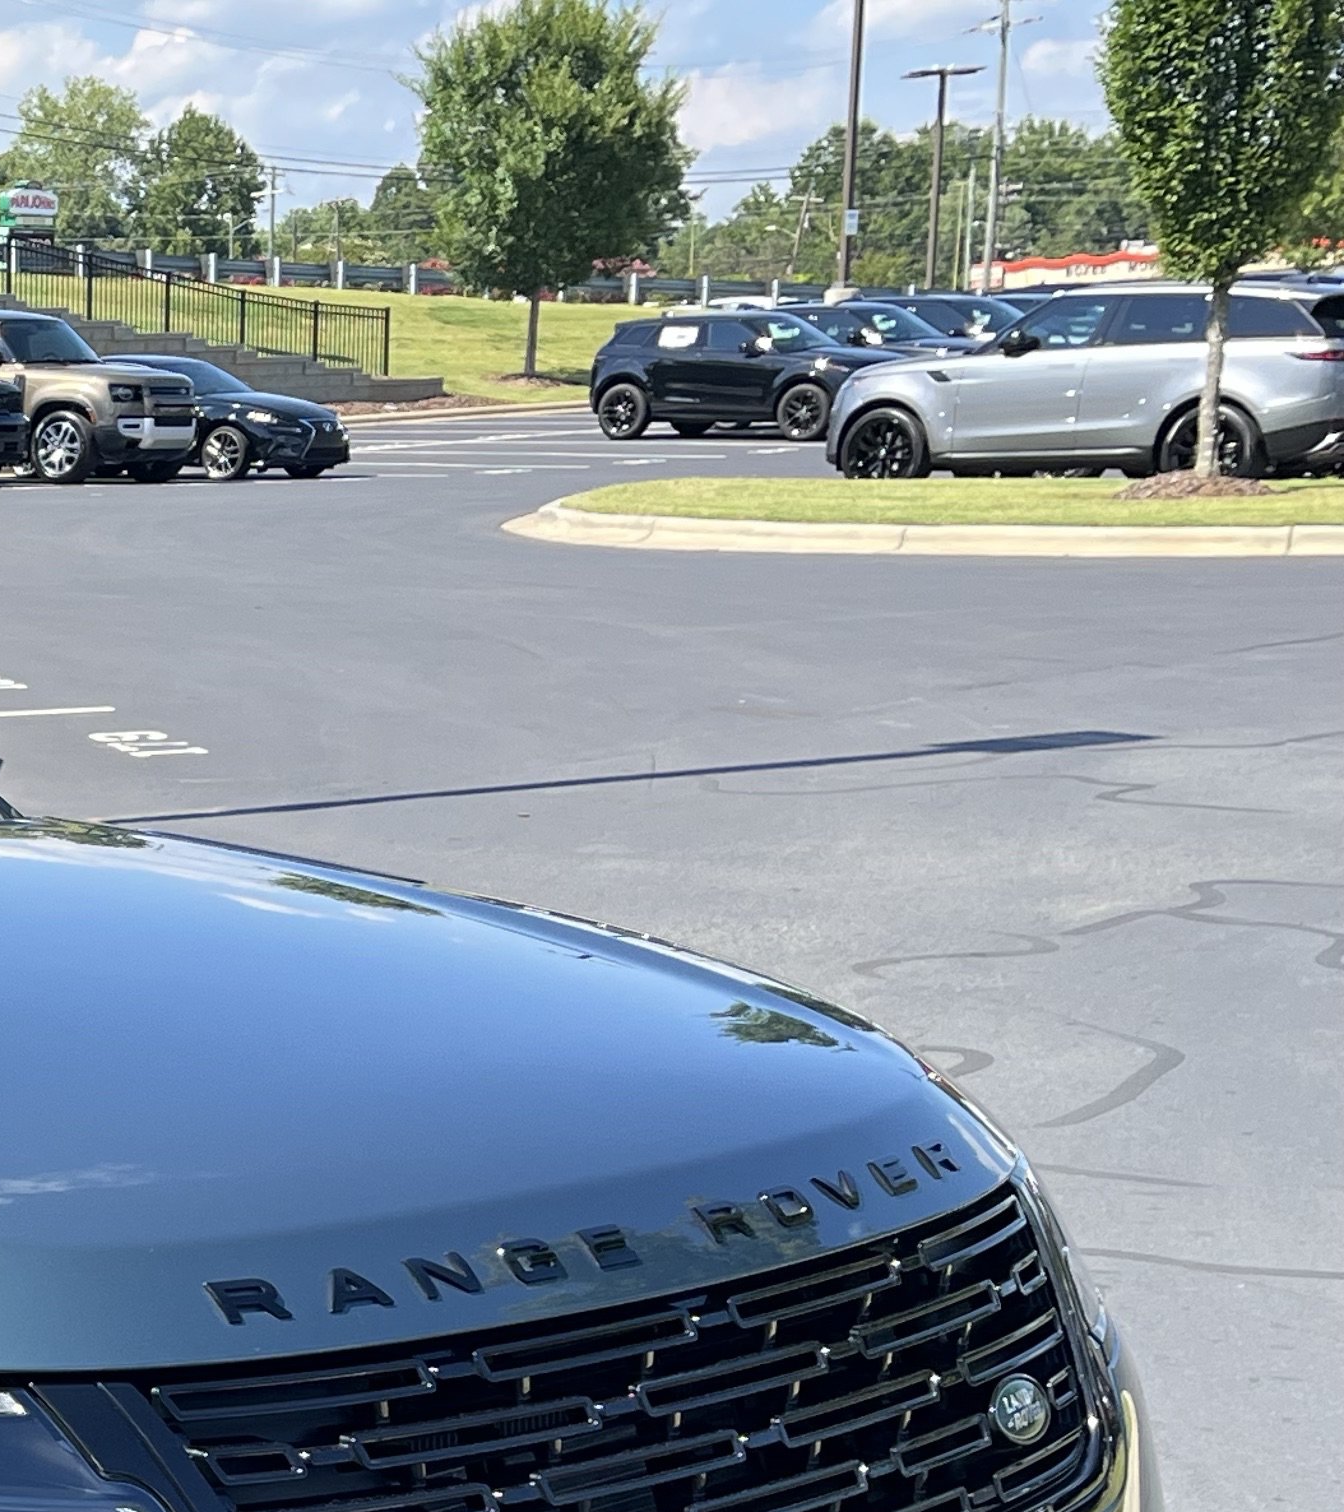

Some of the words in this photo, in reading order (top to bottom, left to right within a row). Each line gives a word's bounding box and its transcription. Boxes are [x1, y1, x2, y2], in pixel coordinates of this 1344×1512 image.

[88, 730, 208, 757] 179
[202, 1224, 640, 1326] RANGE
[691, 1141, 962, 1245] ROVER
